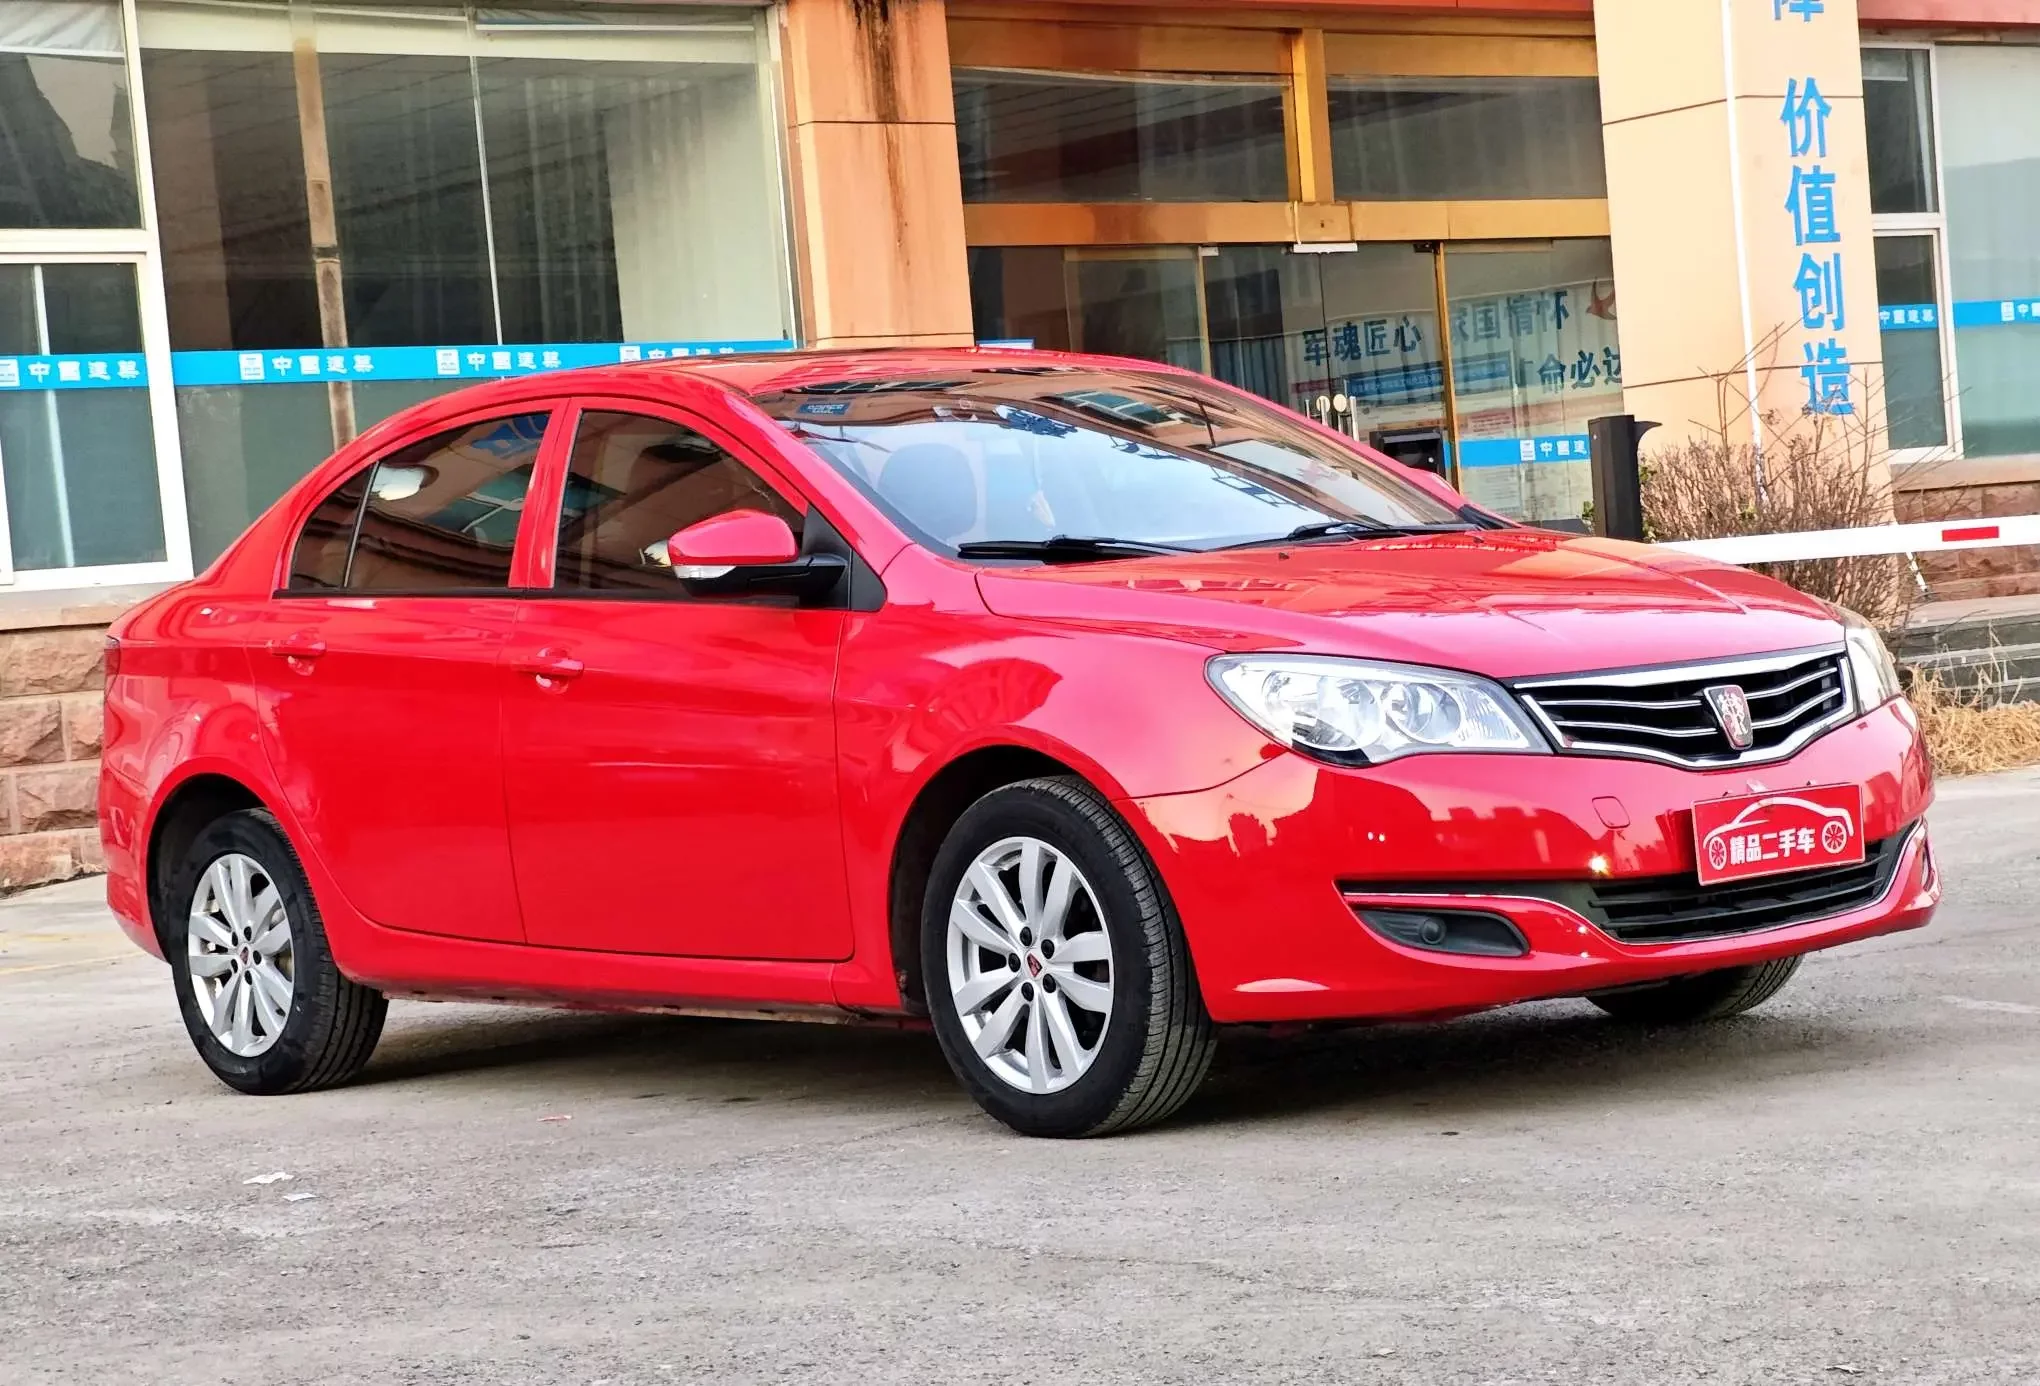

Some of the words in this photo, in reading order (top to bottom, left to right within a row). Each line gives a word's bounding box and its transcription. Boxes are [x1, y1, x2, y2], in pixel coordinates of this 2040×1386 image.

[1779, 77, 1855, 416] 价值创造
[1302, 315, 1422, 367] 军魂匠心
[1730, 827, 1816, 866] 精品二手车
